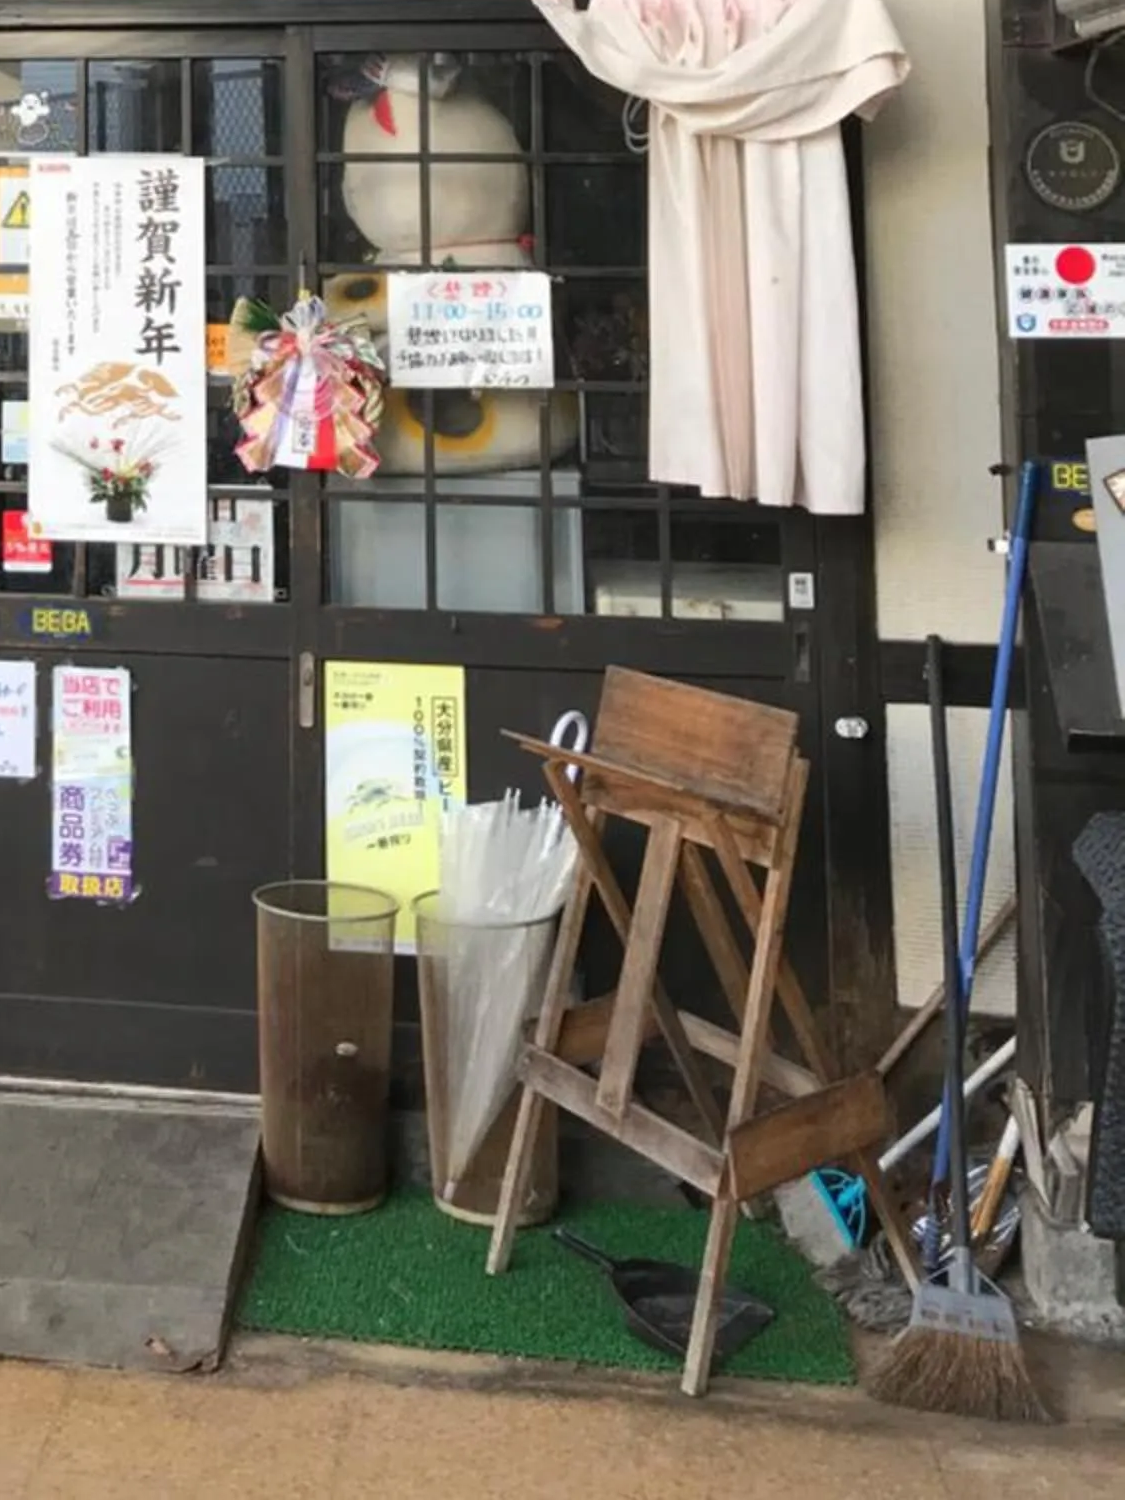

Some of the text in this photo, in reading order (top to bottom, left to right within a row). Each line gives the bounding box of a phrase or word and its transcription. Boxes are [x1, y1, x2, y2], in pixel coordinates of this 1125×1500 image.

[134, 168, 182, 366] 謹賀新年
[32, 608, 91, 634] BEBA
[62, 674, 121, 696] 当店で
[62, 700, 122, 720] ご利用
[59, 785, 85, 867] 商品券
[59, 873, 124, 897] 取扱店
